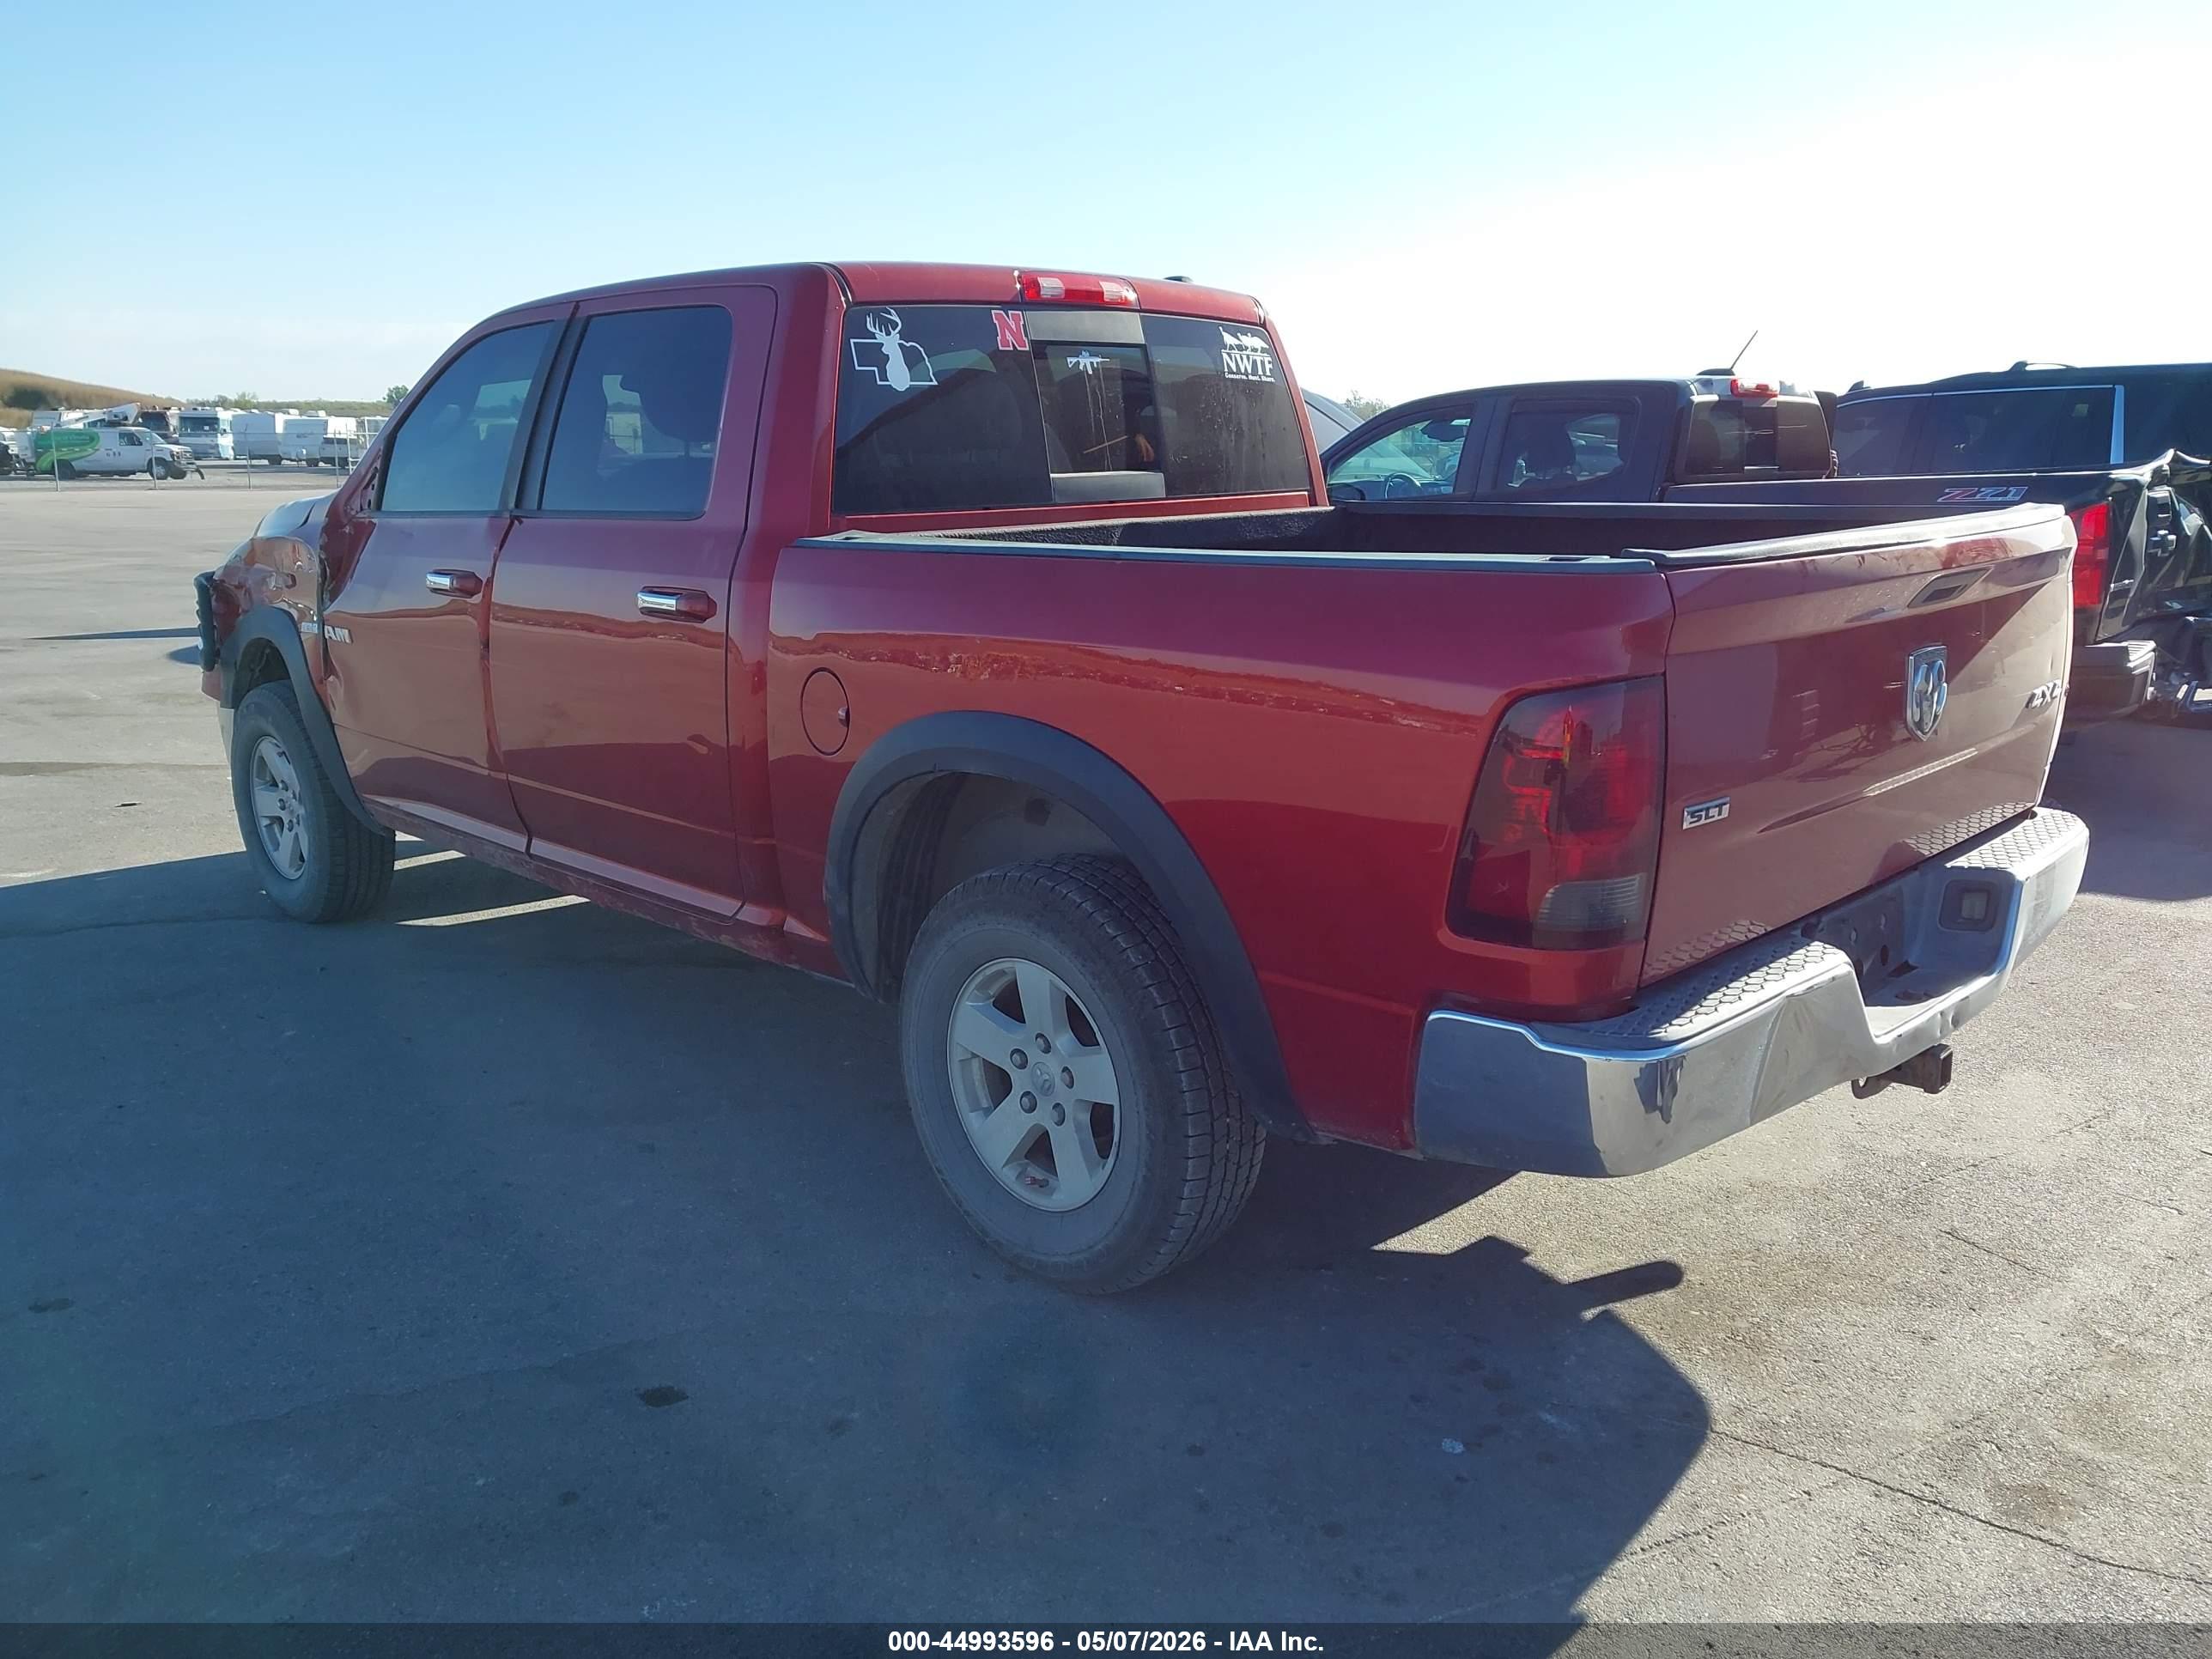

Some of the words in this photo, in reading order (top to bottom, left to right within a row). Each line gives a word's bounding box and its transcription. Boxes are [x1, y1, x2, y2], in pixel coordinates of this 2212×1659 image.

[991, 310, 1030, 350] N
[1222, 352, 1273, 376] NWTF
[1936, 486, 2028, 502] Z71
[324, 624, 350, 644] AM
[1687, 801, 1726, 825] SLT
